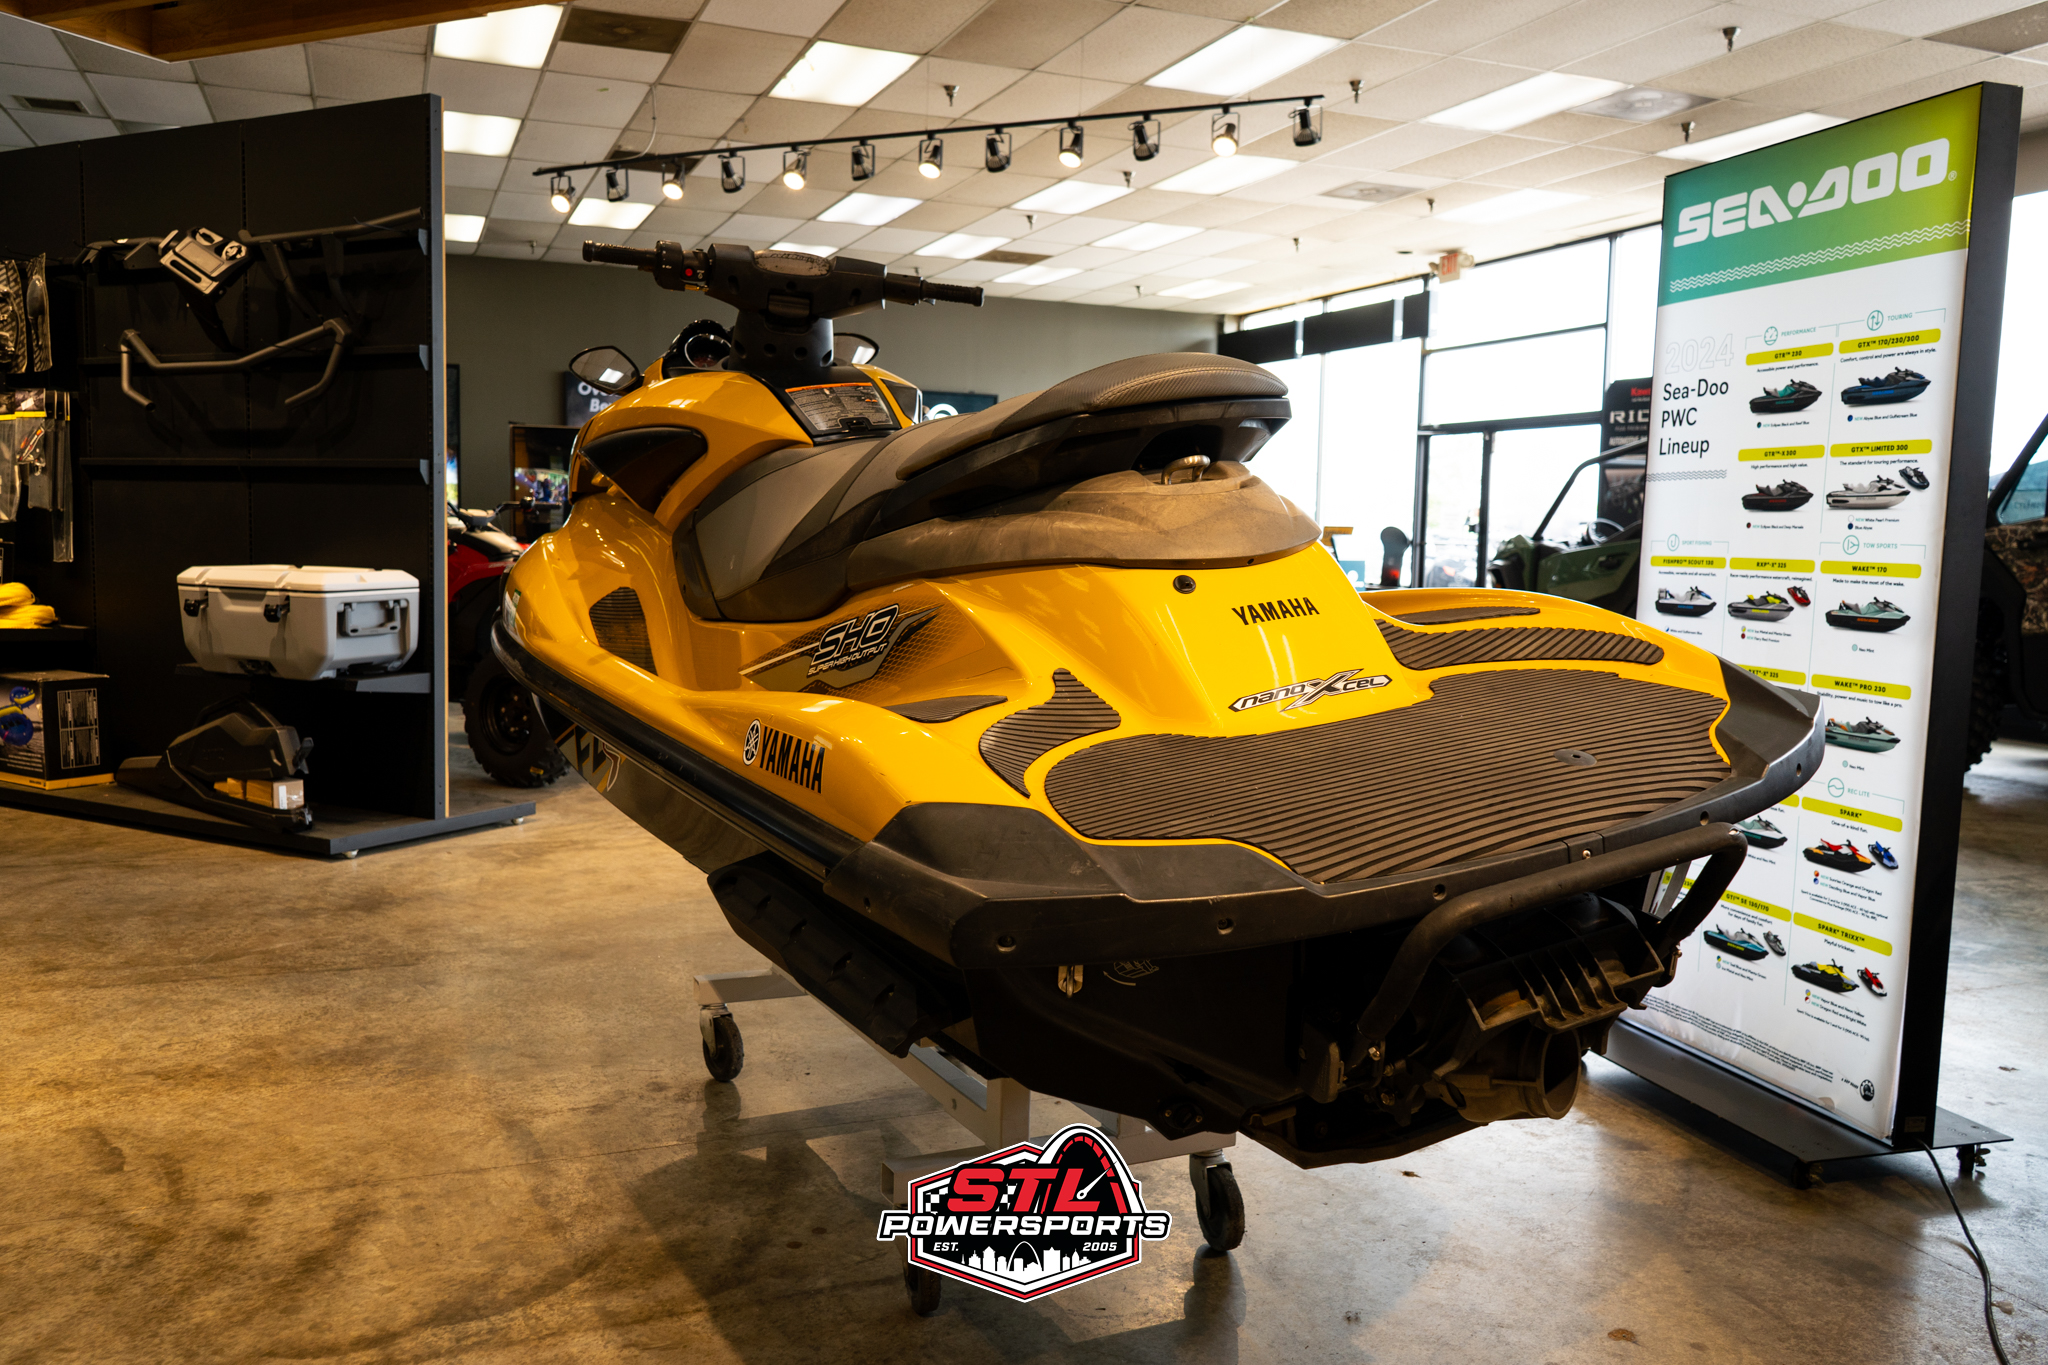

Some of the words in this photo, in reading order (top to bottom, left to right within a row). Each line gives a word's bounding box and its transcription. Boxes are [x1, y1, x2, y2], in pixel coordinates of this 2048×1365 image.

[1441, 253, 1458, 275] EXIT
[1887, 312, 1913, 321] TOURING
[1780, 327, 1817, 337] PERFORMANCE
[1664, 333, 1735, 375] 2024
[1663, 378, 1729, 401] Sea-Doo
[1661, 407, 1697, 429] PWC
[1659, 437, 1710, 458] Lineup
[1871, 444, 1894, 452] LIMITED
[1231, 597, 1320, 626] YAMAHA
[810, 603, 899, 666] SHO
[1859, 684, 1872, 692] PRO
[1874, 685, 1886, 693] 230
[759, 726, 826, 794] YAMAHA
[1858, 790, 1870, 798] LITE
